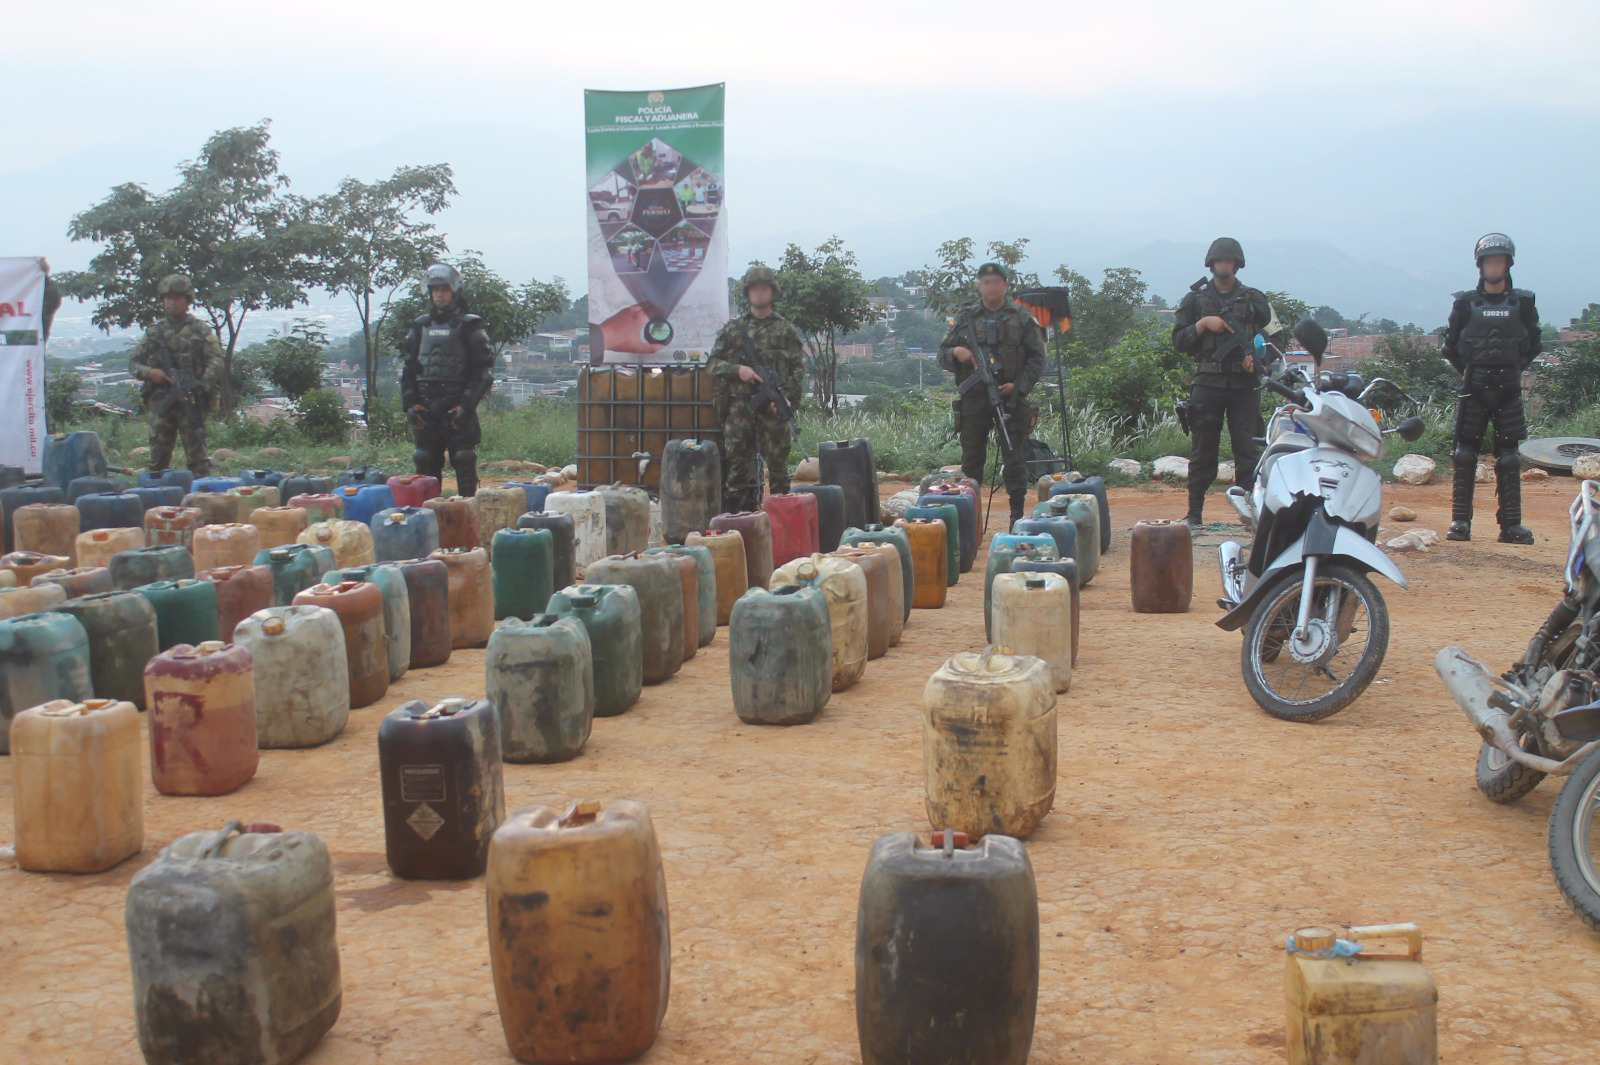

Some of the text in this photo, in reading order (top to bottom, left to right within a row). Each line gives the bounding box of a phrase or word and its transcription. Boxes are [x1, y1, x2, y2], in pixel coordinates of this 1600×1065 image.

[638, 105, 672, 115] POLICÍA
[615, 115, 645, 124] FISCAL
[652, 112, 699, 122] ADUANERA
[26, 359, 38, 457] www.ejercito.mil.co
